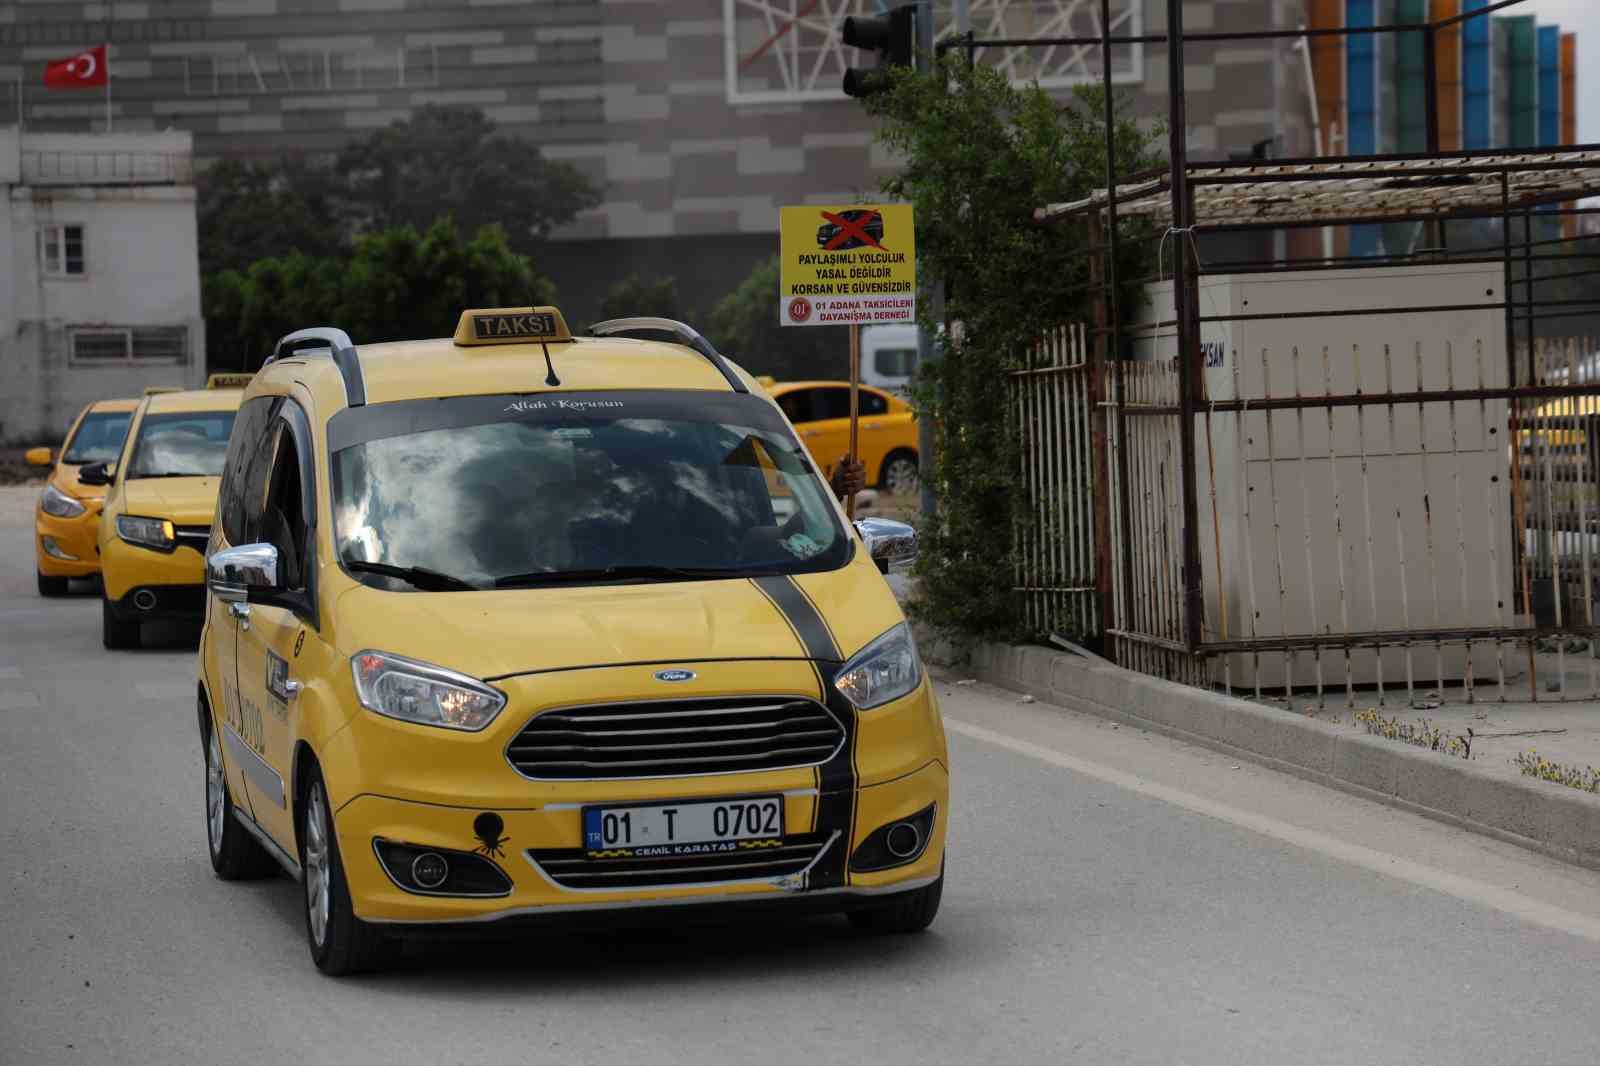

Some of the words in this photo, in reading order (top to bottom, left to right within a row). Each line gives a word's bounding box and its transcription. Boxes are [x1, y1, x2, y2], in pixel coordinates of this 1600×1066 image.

[859, 253, 905, 263] YOLCULUK
[816, 268, 847, 279] YASAL
[792, 284, 833, 294] KORSAN
[837, 283, 849, 293] VE
[816, 302, 826, 310] 01
[830, 301, 861, 310] ADANA
[504, 400, 547, 412] Allah
[552, 399, 624, 412] Korusun
[587, 832, 600, 842] TR
[603, 812, 631, 844] 01
[662, 809, 678, 841] T
[713, 803, 779, 837] 0702
